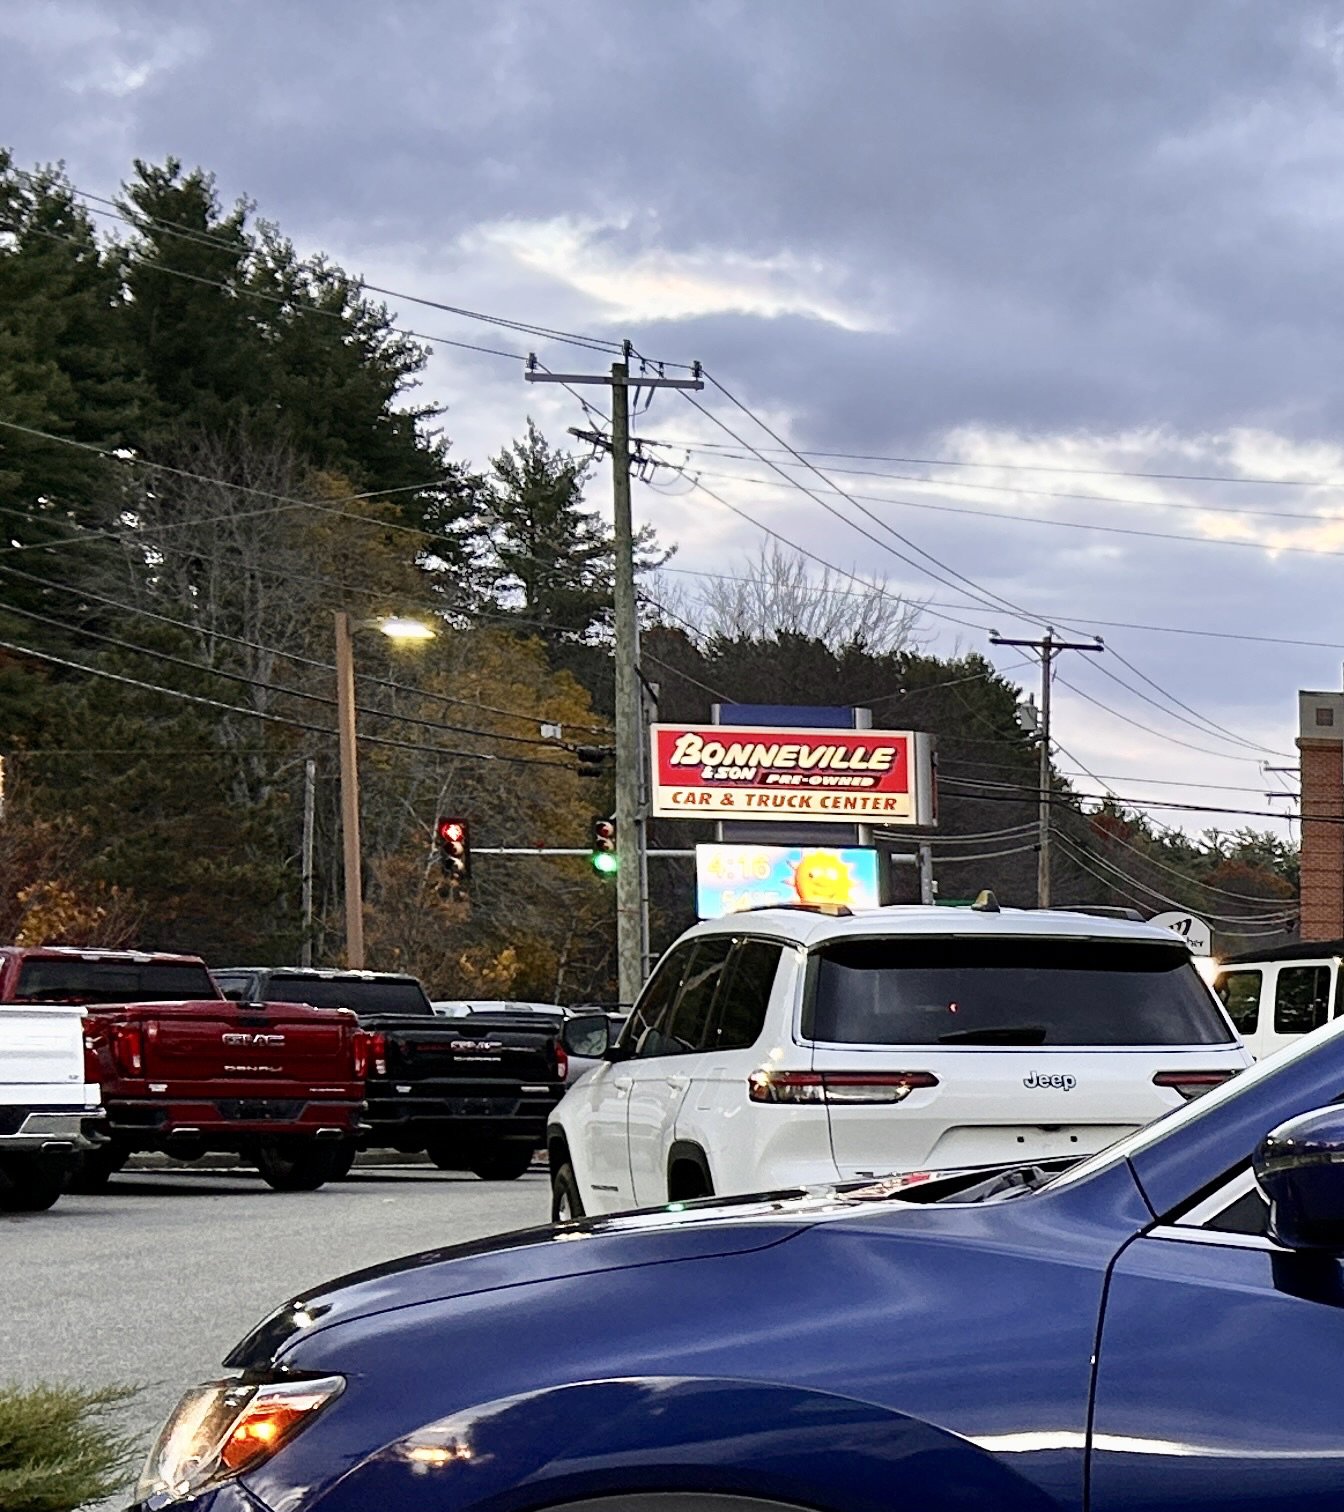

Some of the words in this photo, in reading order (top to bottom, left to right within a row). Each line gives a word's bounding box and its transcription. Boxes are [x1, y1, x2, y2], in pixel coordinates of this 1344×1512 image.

[671, 733, 896, 770] BONNEVILLE
[714, 767, 756, 781] SON
[766, 772, 875, 787] PRE-OWNED
[672, 791, 712, 806] CAR
[720, 793, 735, 807] &
[746, 794, 813, 809] TRUCK
[820, 796, 897, 811] CENTER
[1023, 1070, 1077, 1092] Jeep
